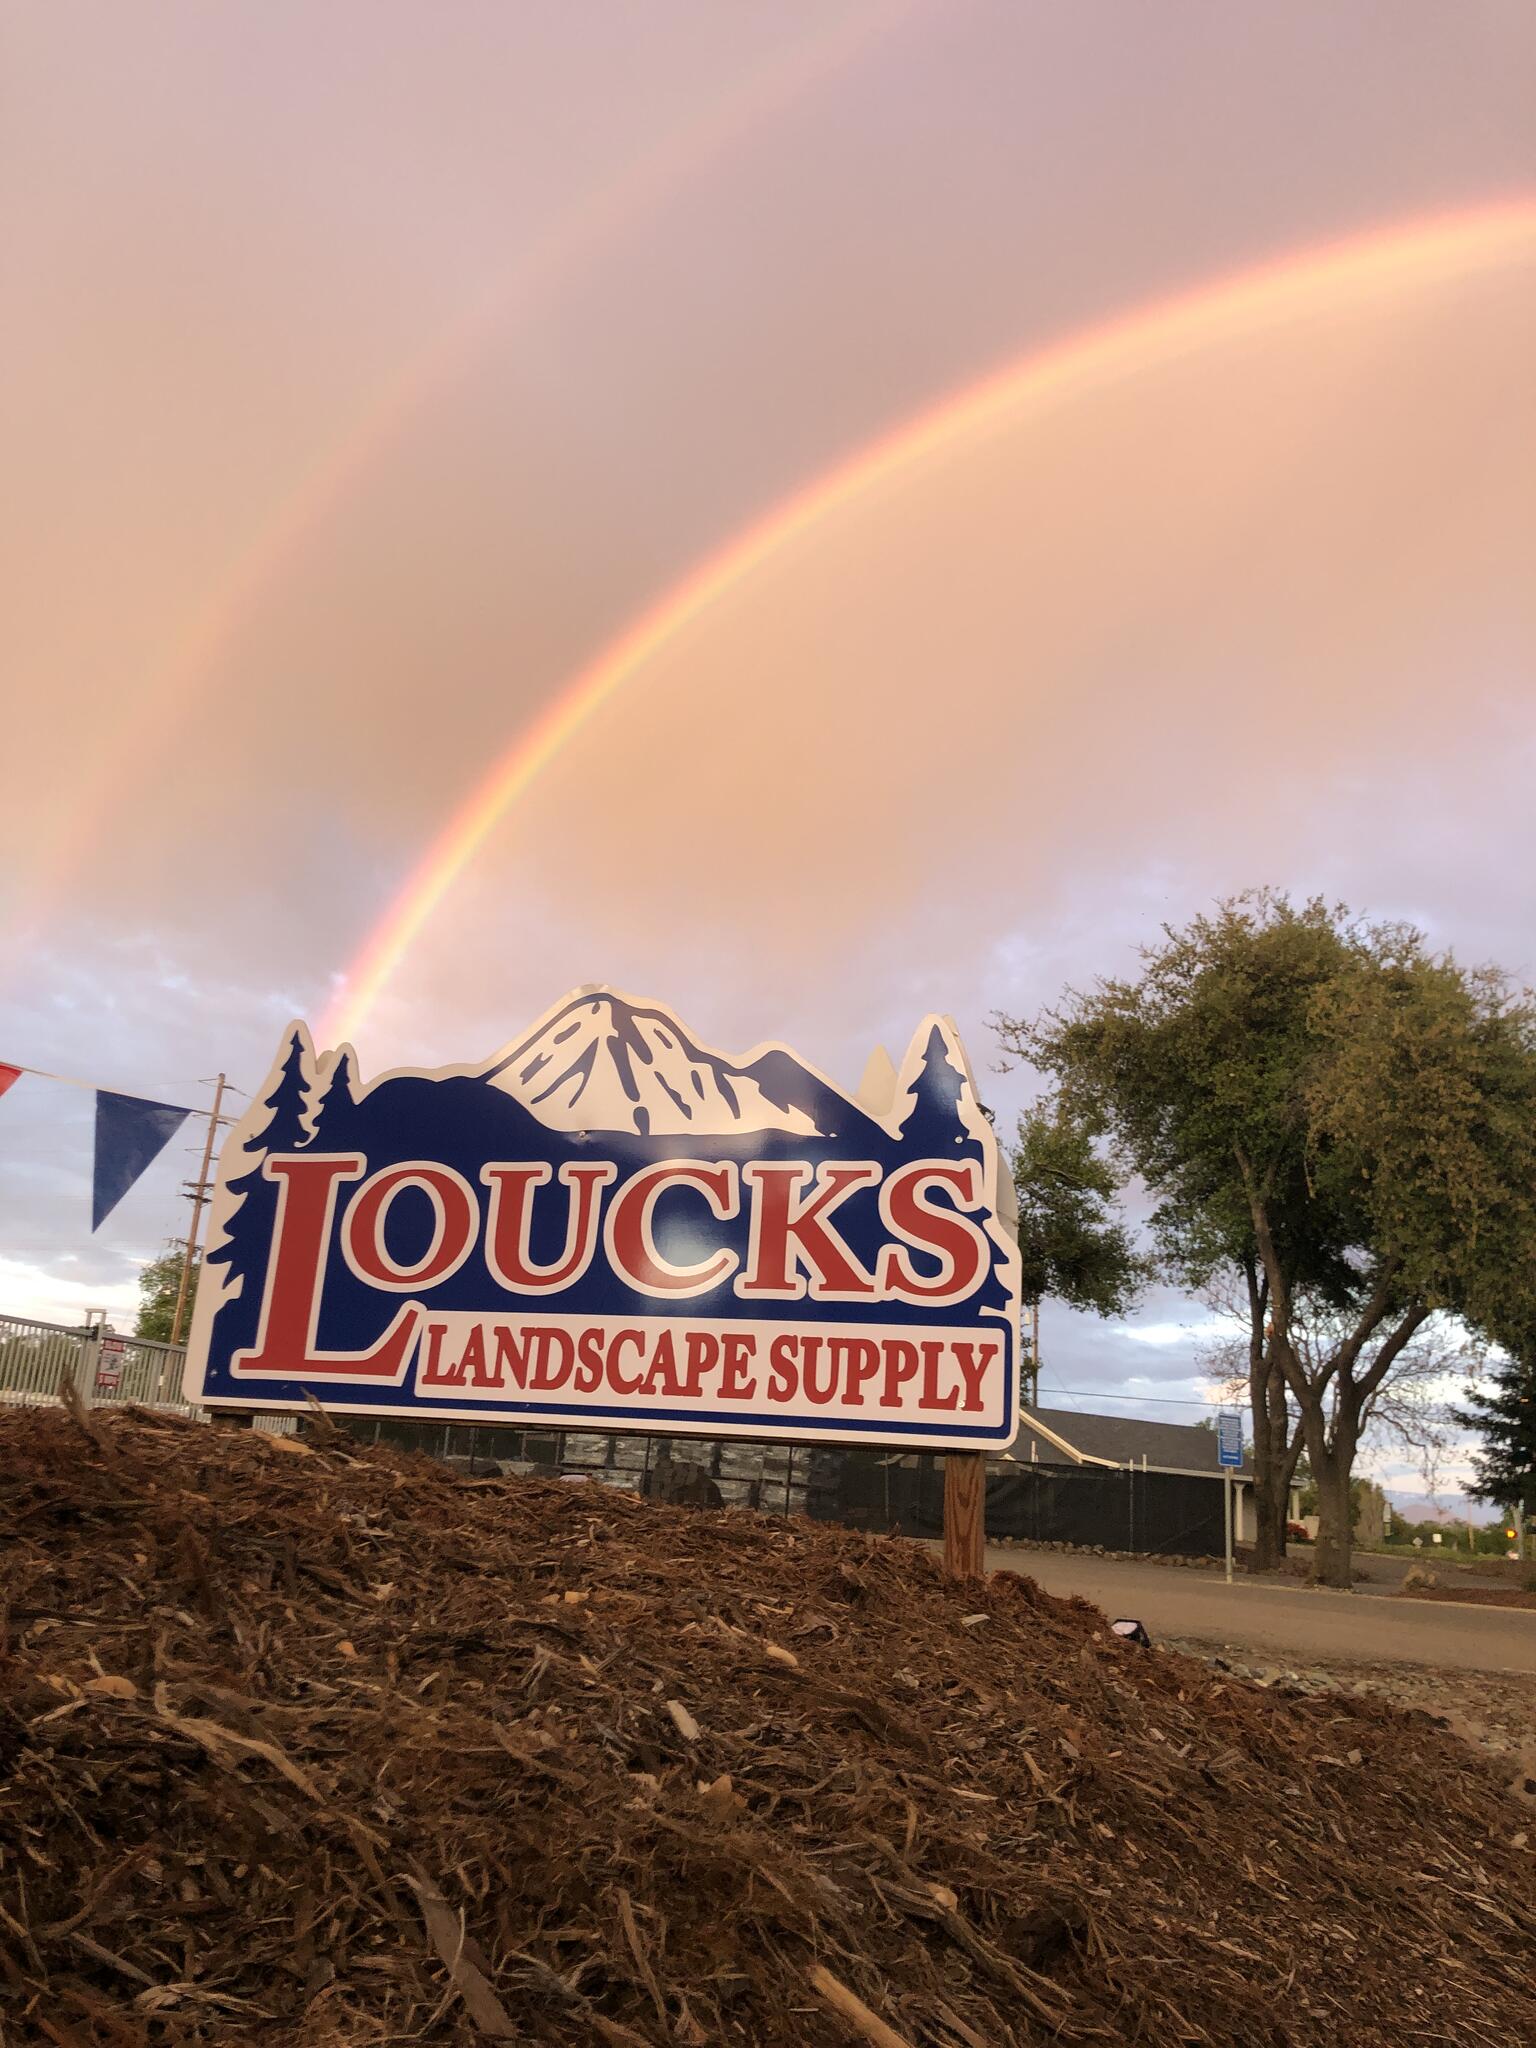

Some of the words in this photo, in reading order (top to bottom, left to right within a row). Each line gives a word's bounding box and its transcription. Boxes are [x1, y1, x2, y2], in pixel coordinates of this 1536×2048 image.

[237, 1159, 981, 1377] LOUCKS
[421, 1323, 757, 1400] LANDSCAPE
[767, 1334, 999, 1412] SUPPLY
